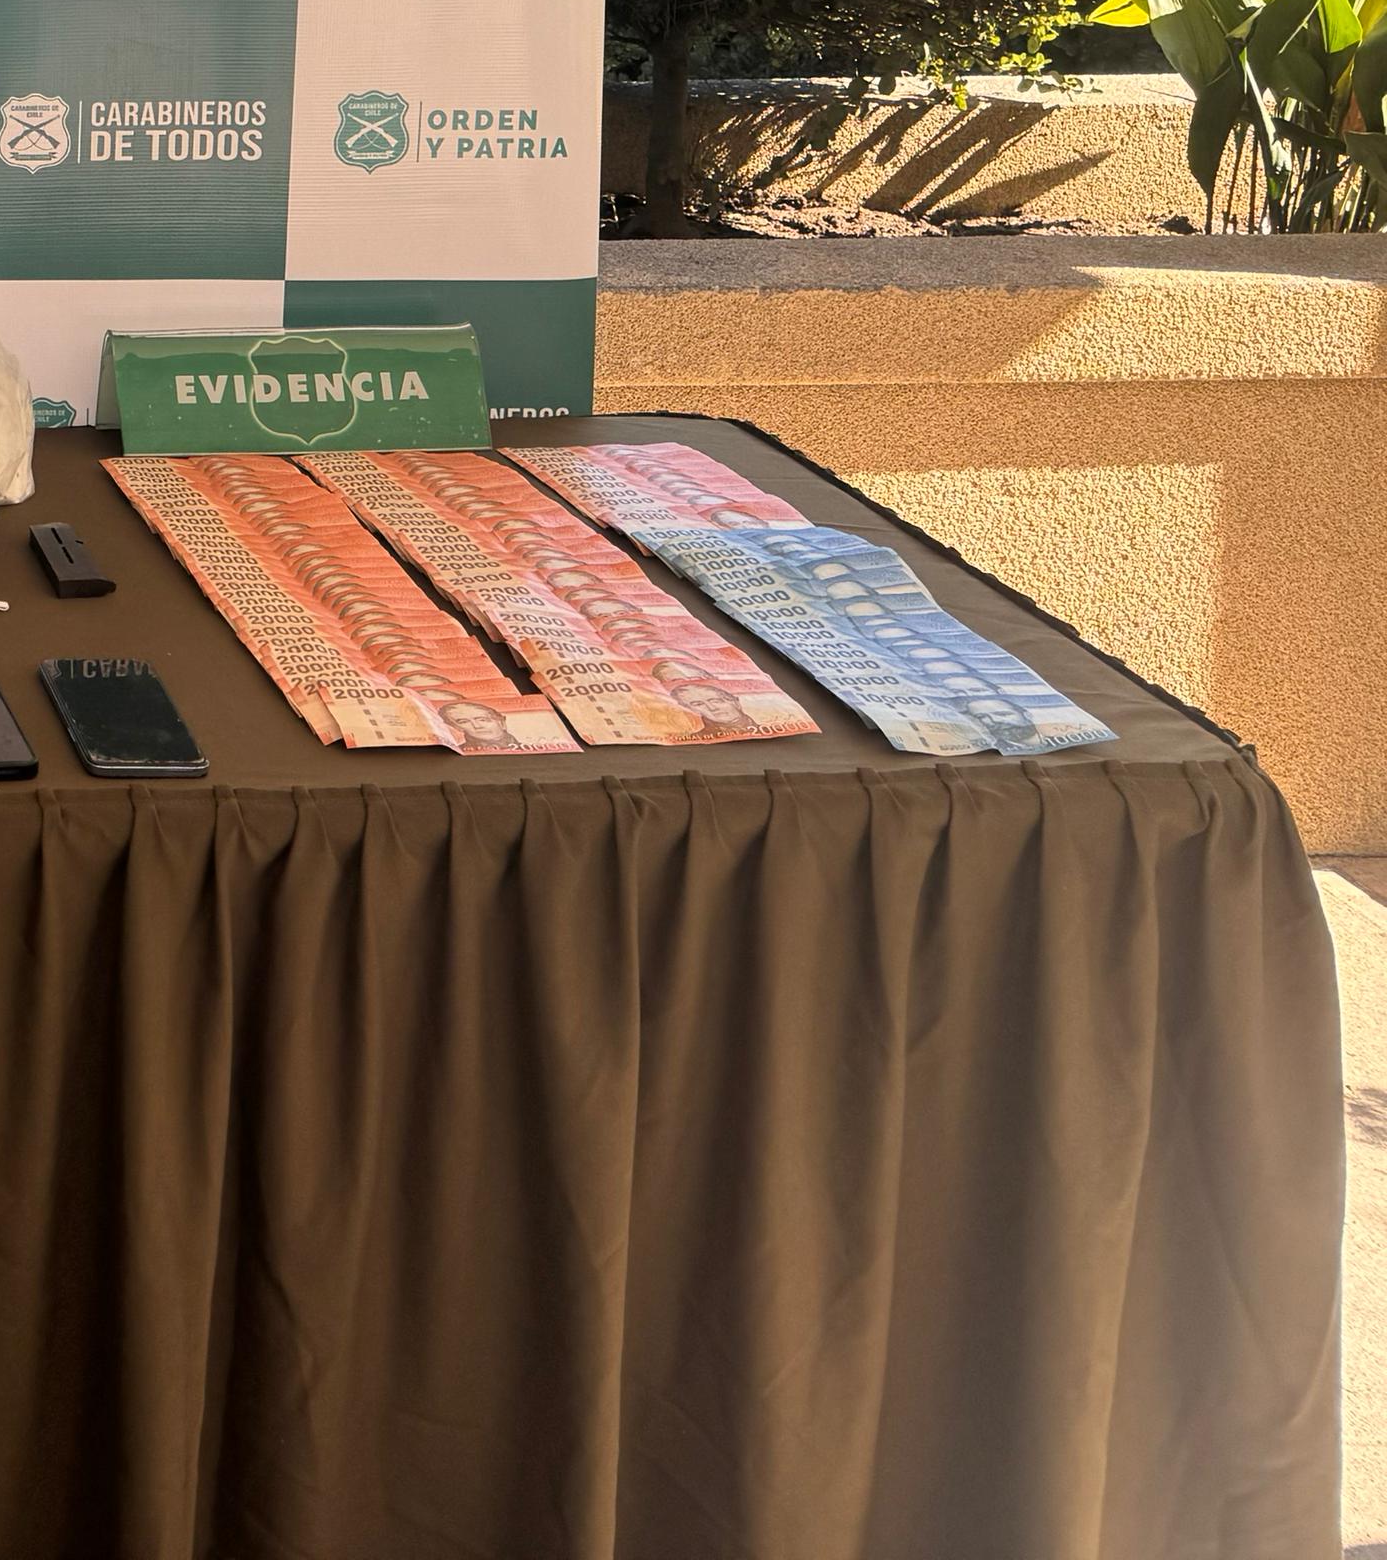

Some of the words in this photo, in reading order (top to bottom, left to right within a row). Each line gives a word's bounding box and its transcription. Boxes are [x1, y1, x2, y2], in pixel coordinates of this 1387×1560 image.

[90, 100, 267, 127] CARABINEROS
[427, 109, 538, 131] ORDEN
[90, 130, 134, 161] DE
[145, 129, 263, 161] TODOS
[426, 137, 445, 159] Y
[457, 137, 568, 158] PATRIA
[175, 371, 430, 404] EVIDENCIA
[320, 464, 378, 474] 20000
[345, 486, 404, 496] 20000
[579, 490, 638, 501] 20000
[151, 499, 209, 509] 20000
[595, 497, 654, 507] 20000
[159, 509, 219, 517] 20000
[169, 523, 228, 534] 20000
[417, 544, 480, 554] 20000
[669, 540, 727, 552] 10000
[196, 554, 258, 565] 20000
[686, 548, 745, 562] 10000
[437, 561, 500, 571] 20000
[699, 557, 760, 571] 10000
[208, 572, 270, 581] 20000
[449, 572, 512, 585] 20000
[714, 574, 776, 591] 10000
[481, 593, 545, 607] 20000
[729, 590, 791, 607] 10000
[239, 605, 305, 615] 20000
[745, 606, 807, 621] 10000
[248, 615, 314, 625] 20000
[500, 613, 565, 627] 20000
[760, 620, 825, 630] 10000
[251, 626, 315, 637] 20000
[535, 641, 604, 656] 20000
[813, 659, 881, 670] 10000
[546, 663, 615, 680] 20000
[835, 676, 900, 686] 10000
[333, 688, 404, 700] 20000
[562, 682, 632, 697] 20000
[858, 694, 925, 706] 10000
[747, 720, 813, 737] 20000
